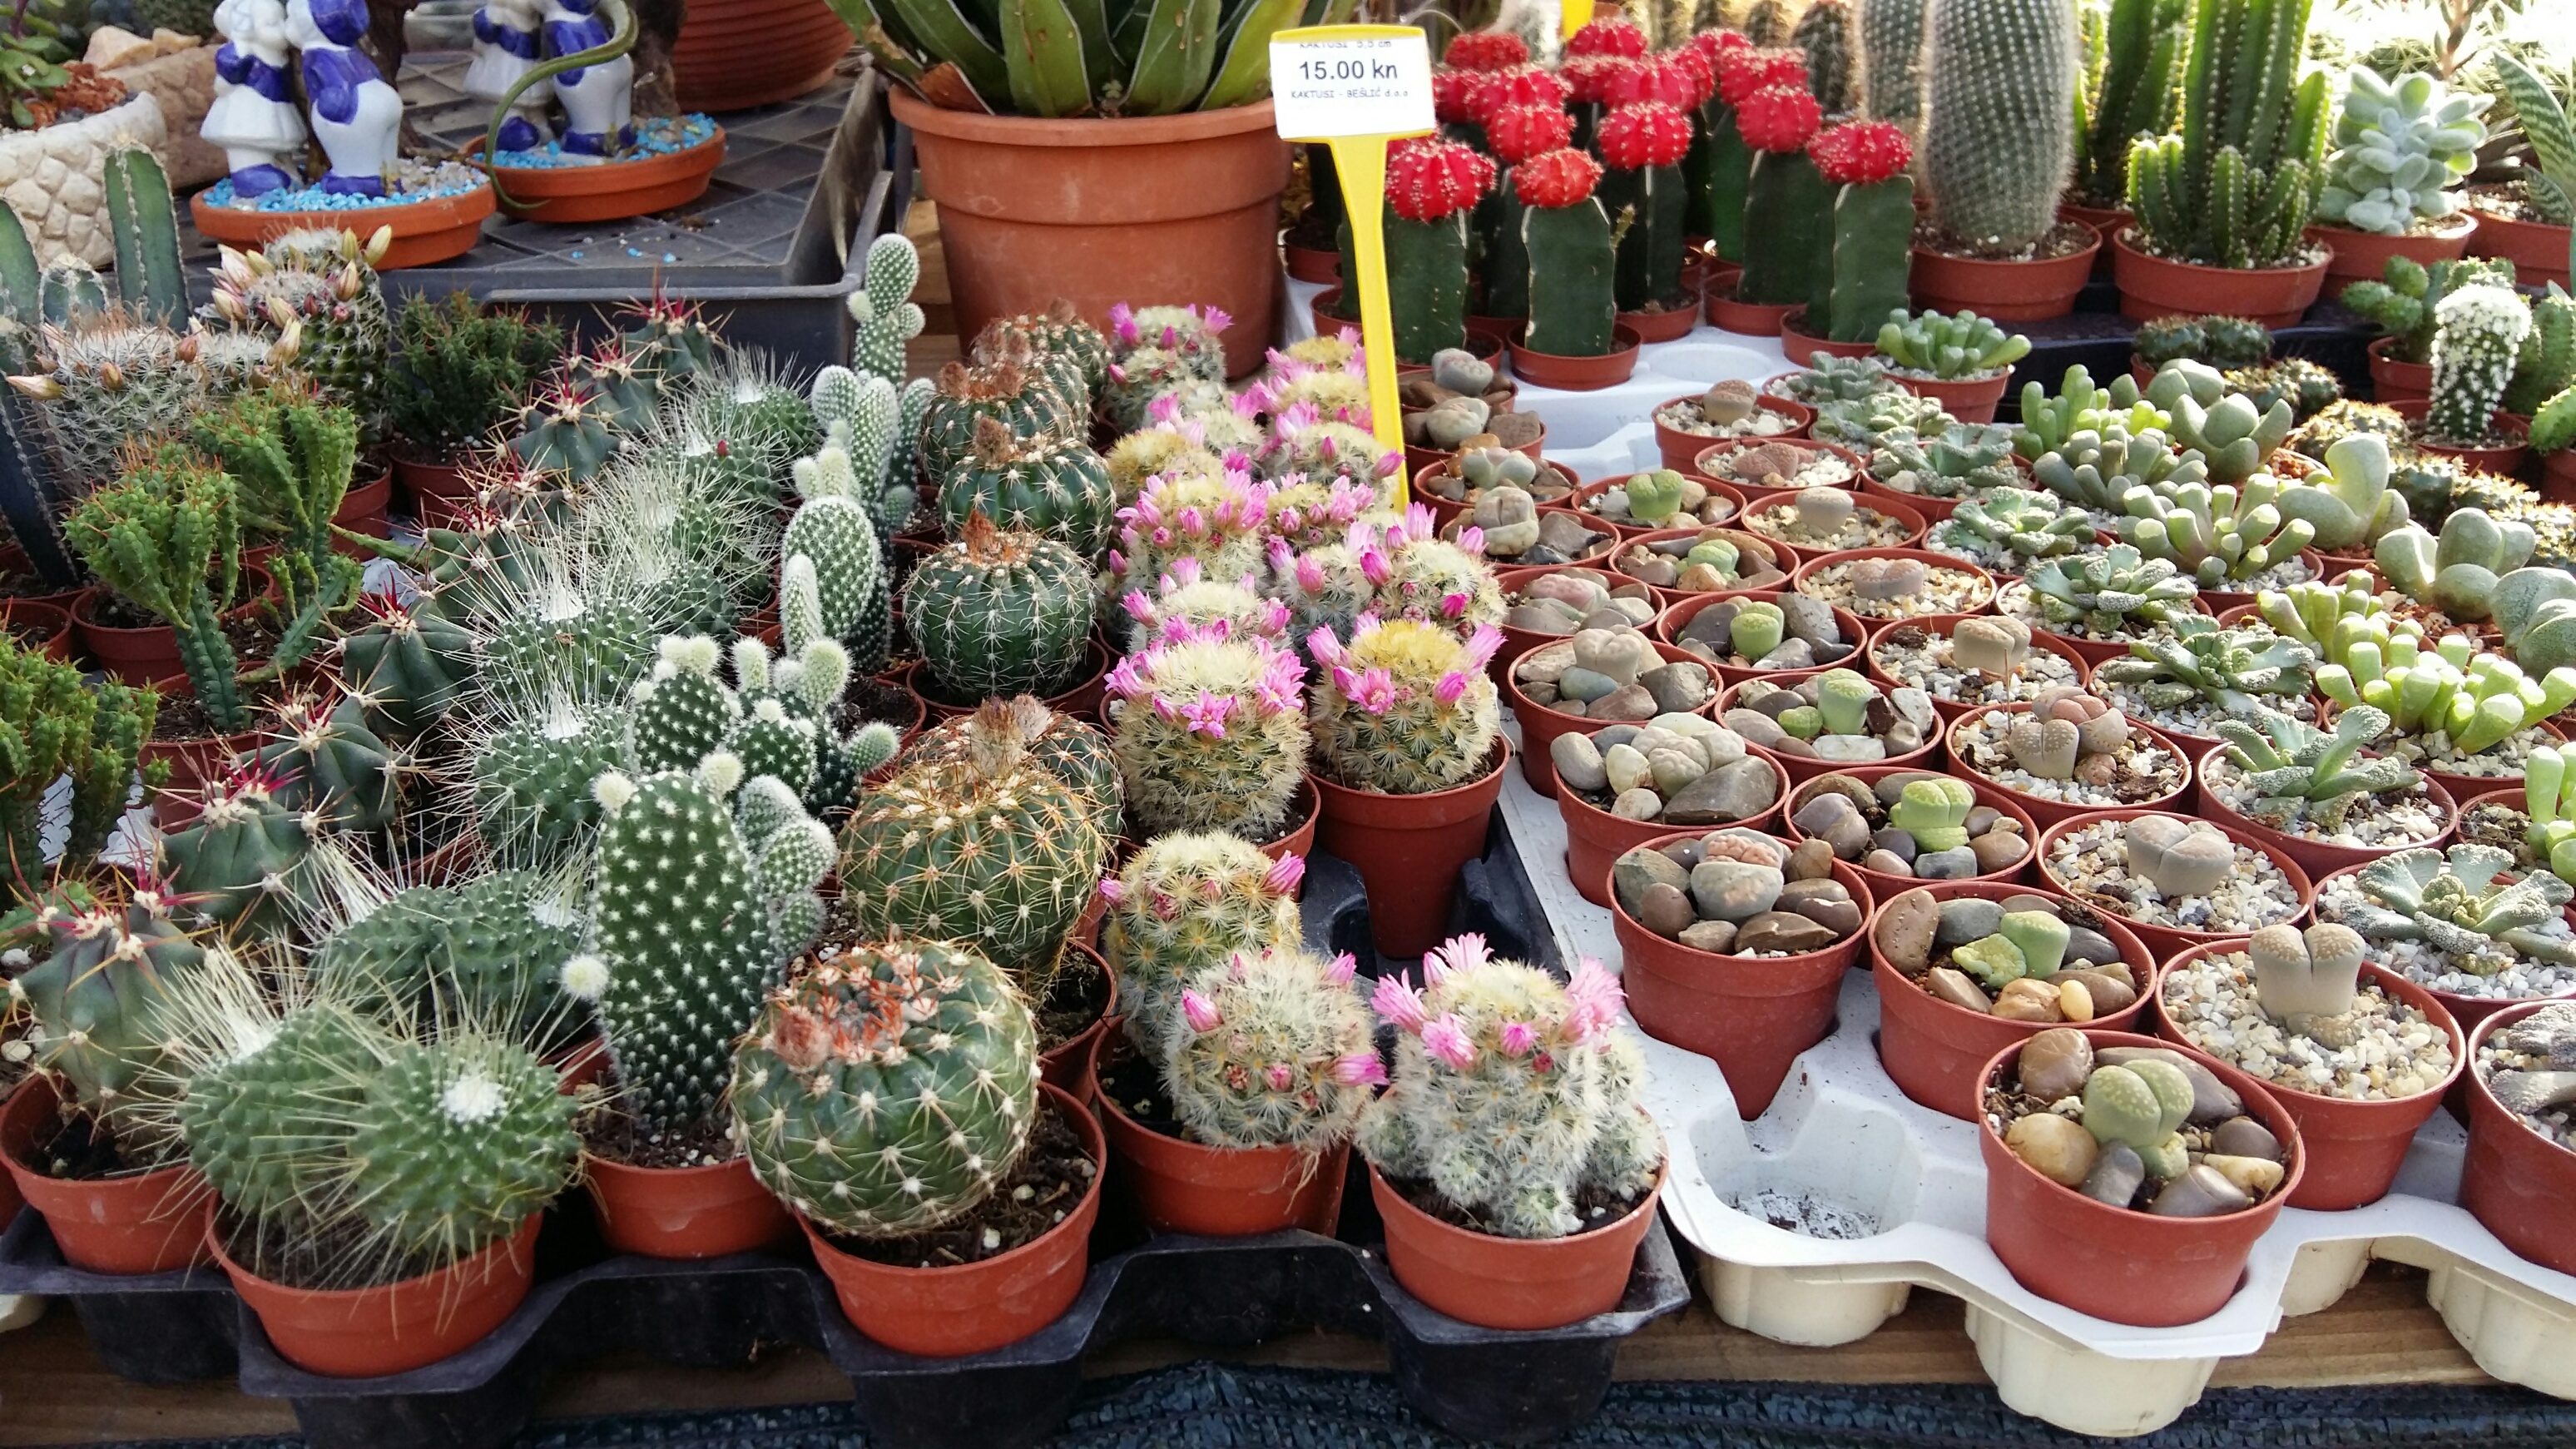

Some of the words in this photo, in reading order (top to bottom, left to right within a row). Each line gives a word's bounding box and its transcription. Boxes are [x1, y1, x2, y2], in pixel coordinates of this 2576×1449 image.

[1299, 60, 1364, 80] 15.00
[1372, 57, 1398, 79] kn
[1290, 90, 1335, 98] KAKTUSI
[1347, 87, 1381, 97] BEŠLIĆ
